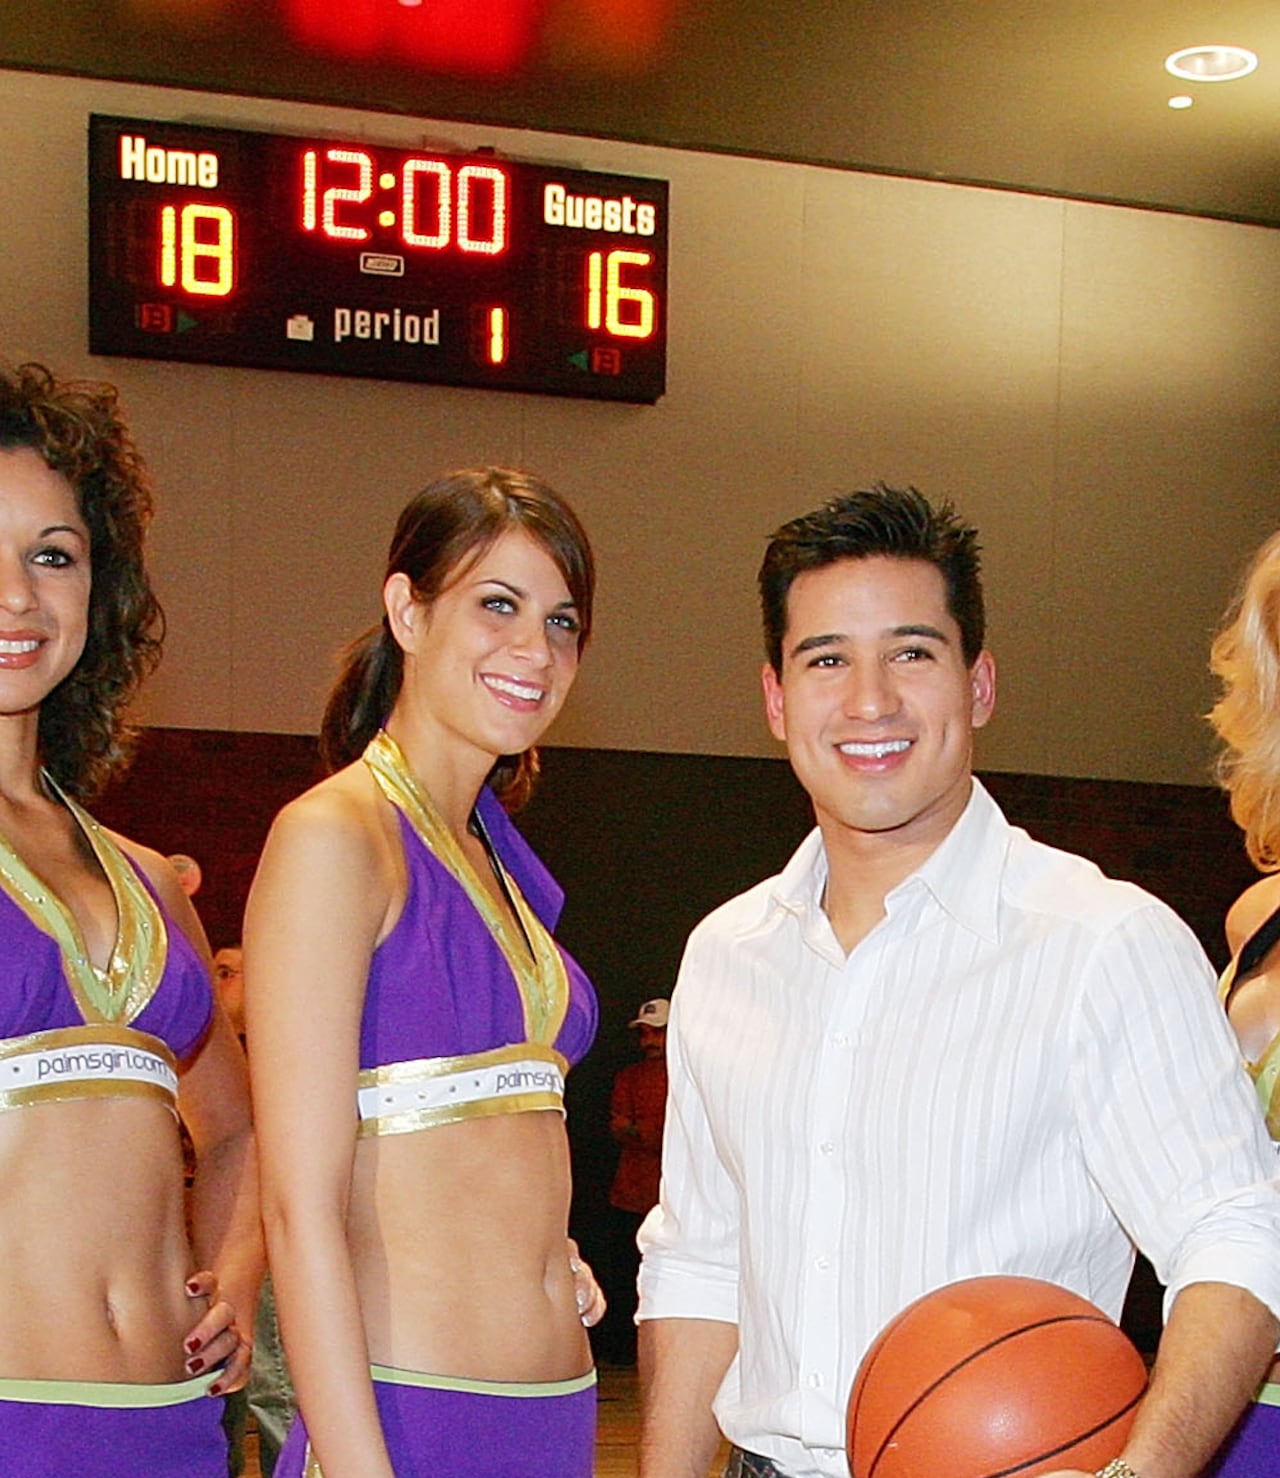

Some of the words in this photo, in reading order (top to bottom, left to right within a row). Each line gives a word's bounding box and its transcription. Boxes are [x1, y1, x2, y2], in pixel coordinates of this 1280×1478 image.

[120, 135, 219, 188] Home
[302, 149, 507, 255] 12:00
[543, 183, 656, 237] Guests
[160, 204, 234, 297] 18
[588, 250, 655, 339] 16
[334, 308, 440, 346] period
[490, 306, 504, 365] 1
[38, 1052, 167, 1079] palmsgirl.com
